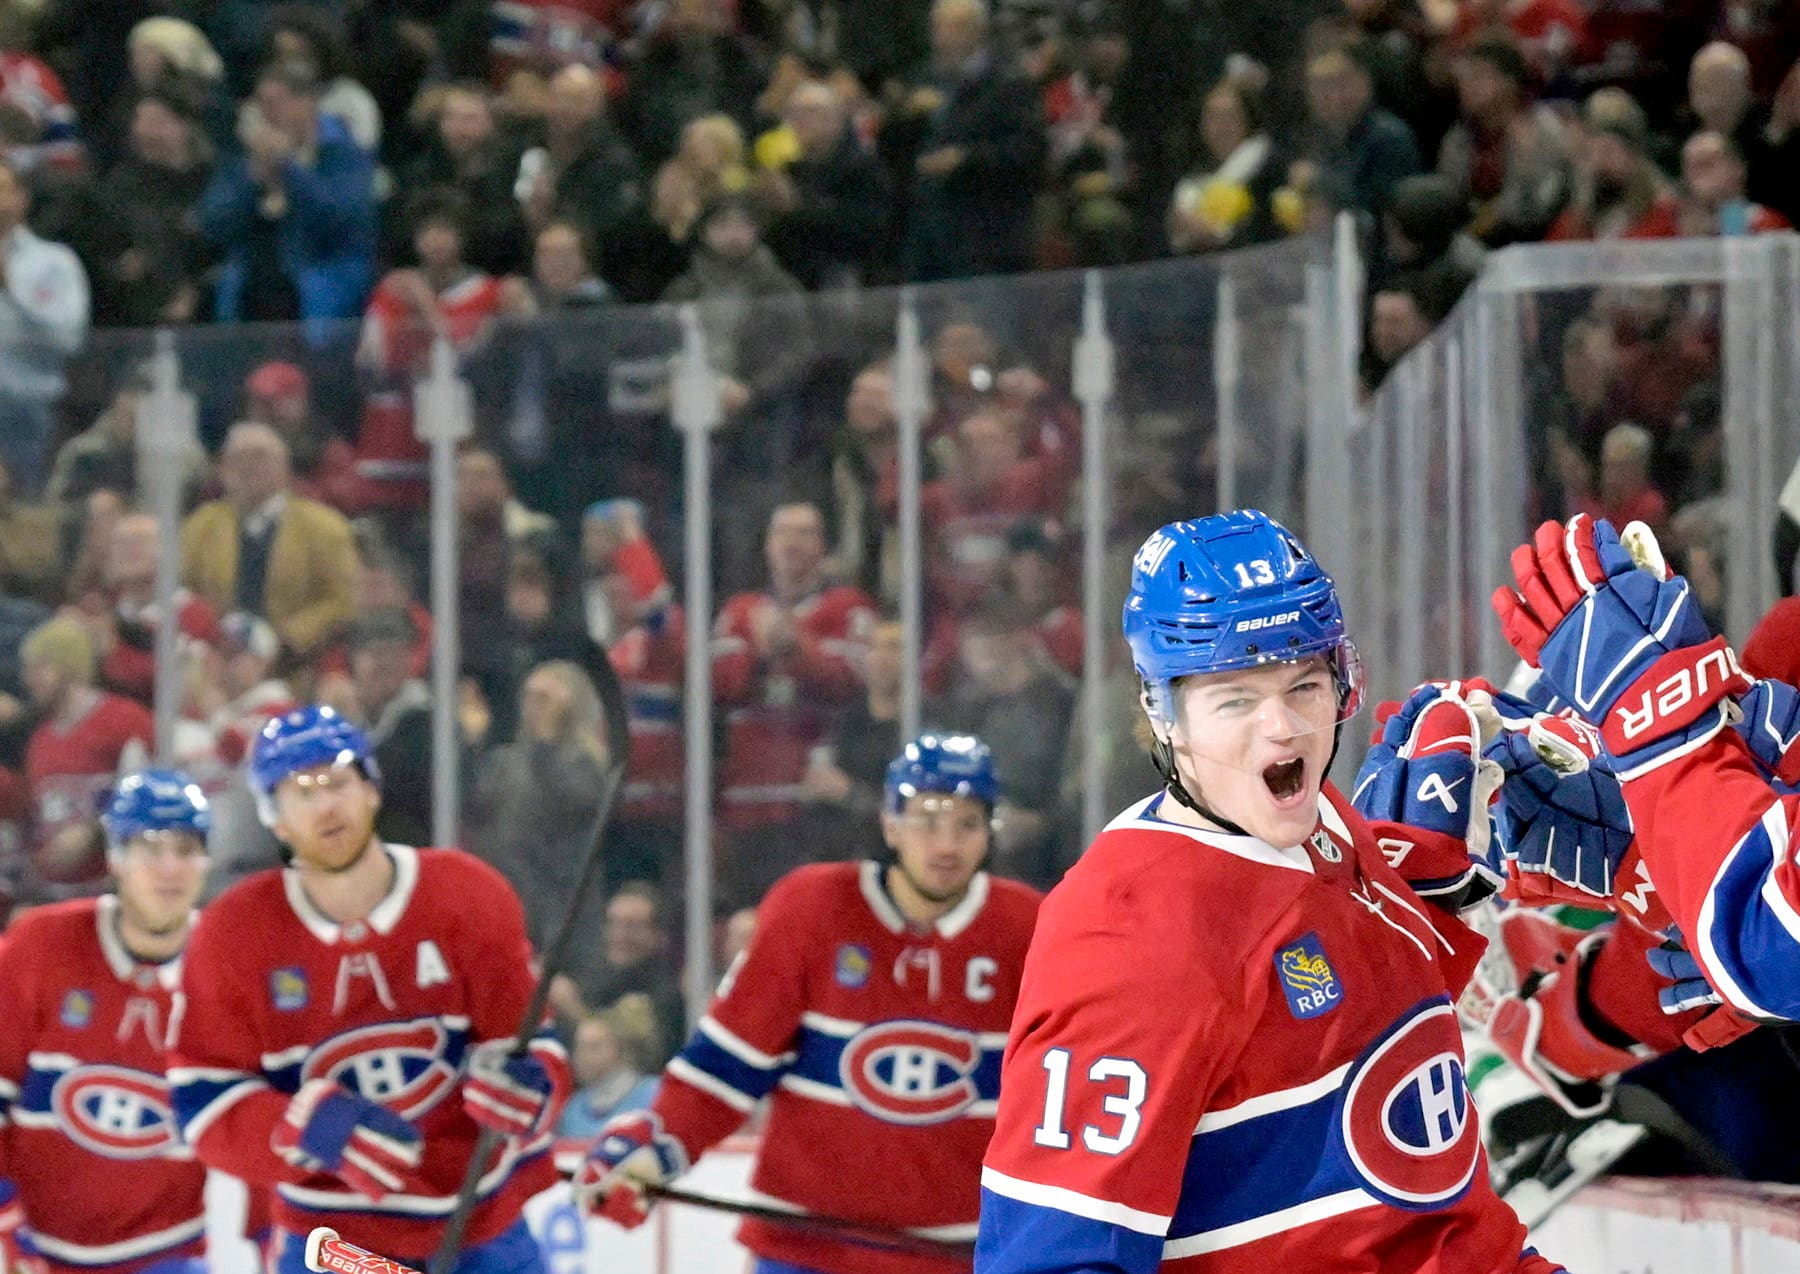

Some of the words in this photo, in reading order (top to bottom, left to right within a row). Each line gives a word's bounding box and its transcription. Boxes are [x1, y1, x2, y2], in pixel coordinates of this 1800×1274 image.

[1233, 559, 1275, 589] 13
[1235, 610, 1300, 633] BAUER
[416, 939, 451, 989] A
[965, 956, 998, 1002] C
[1296, 982, 1340, 1014] RBC
[1034, 1047, 1148, 1156] 13
